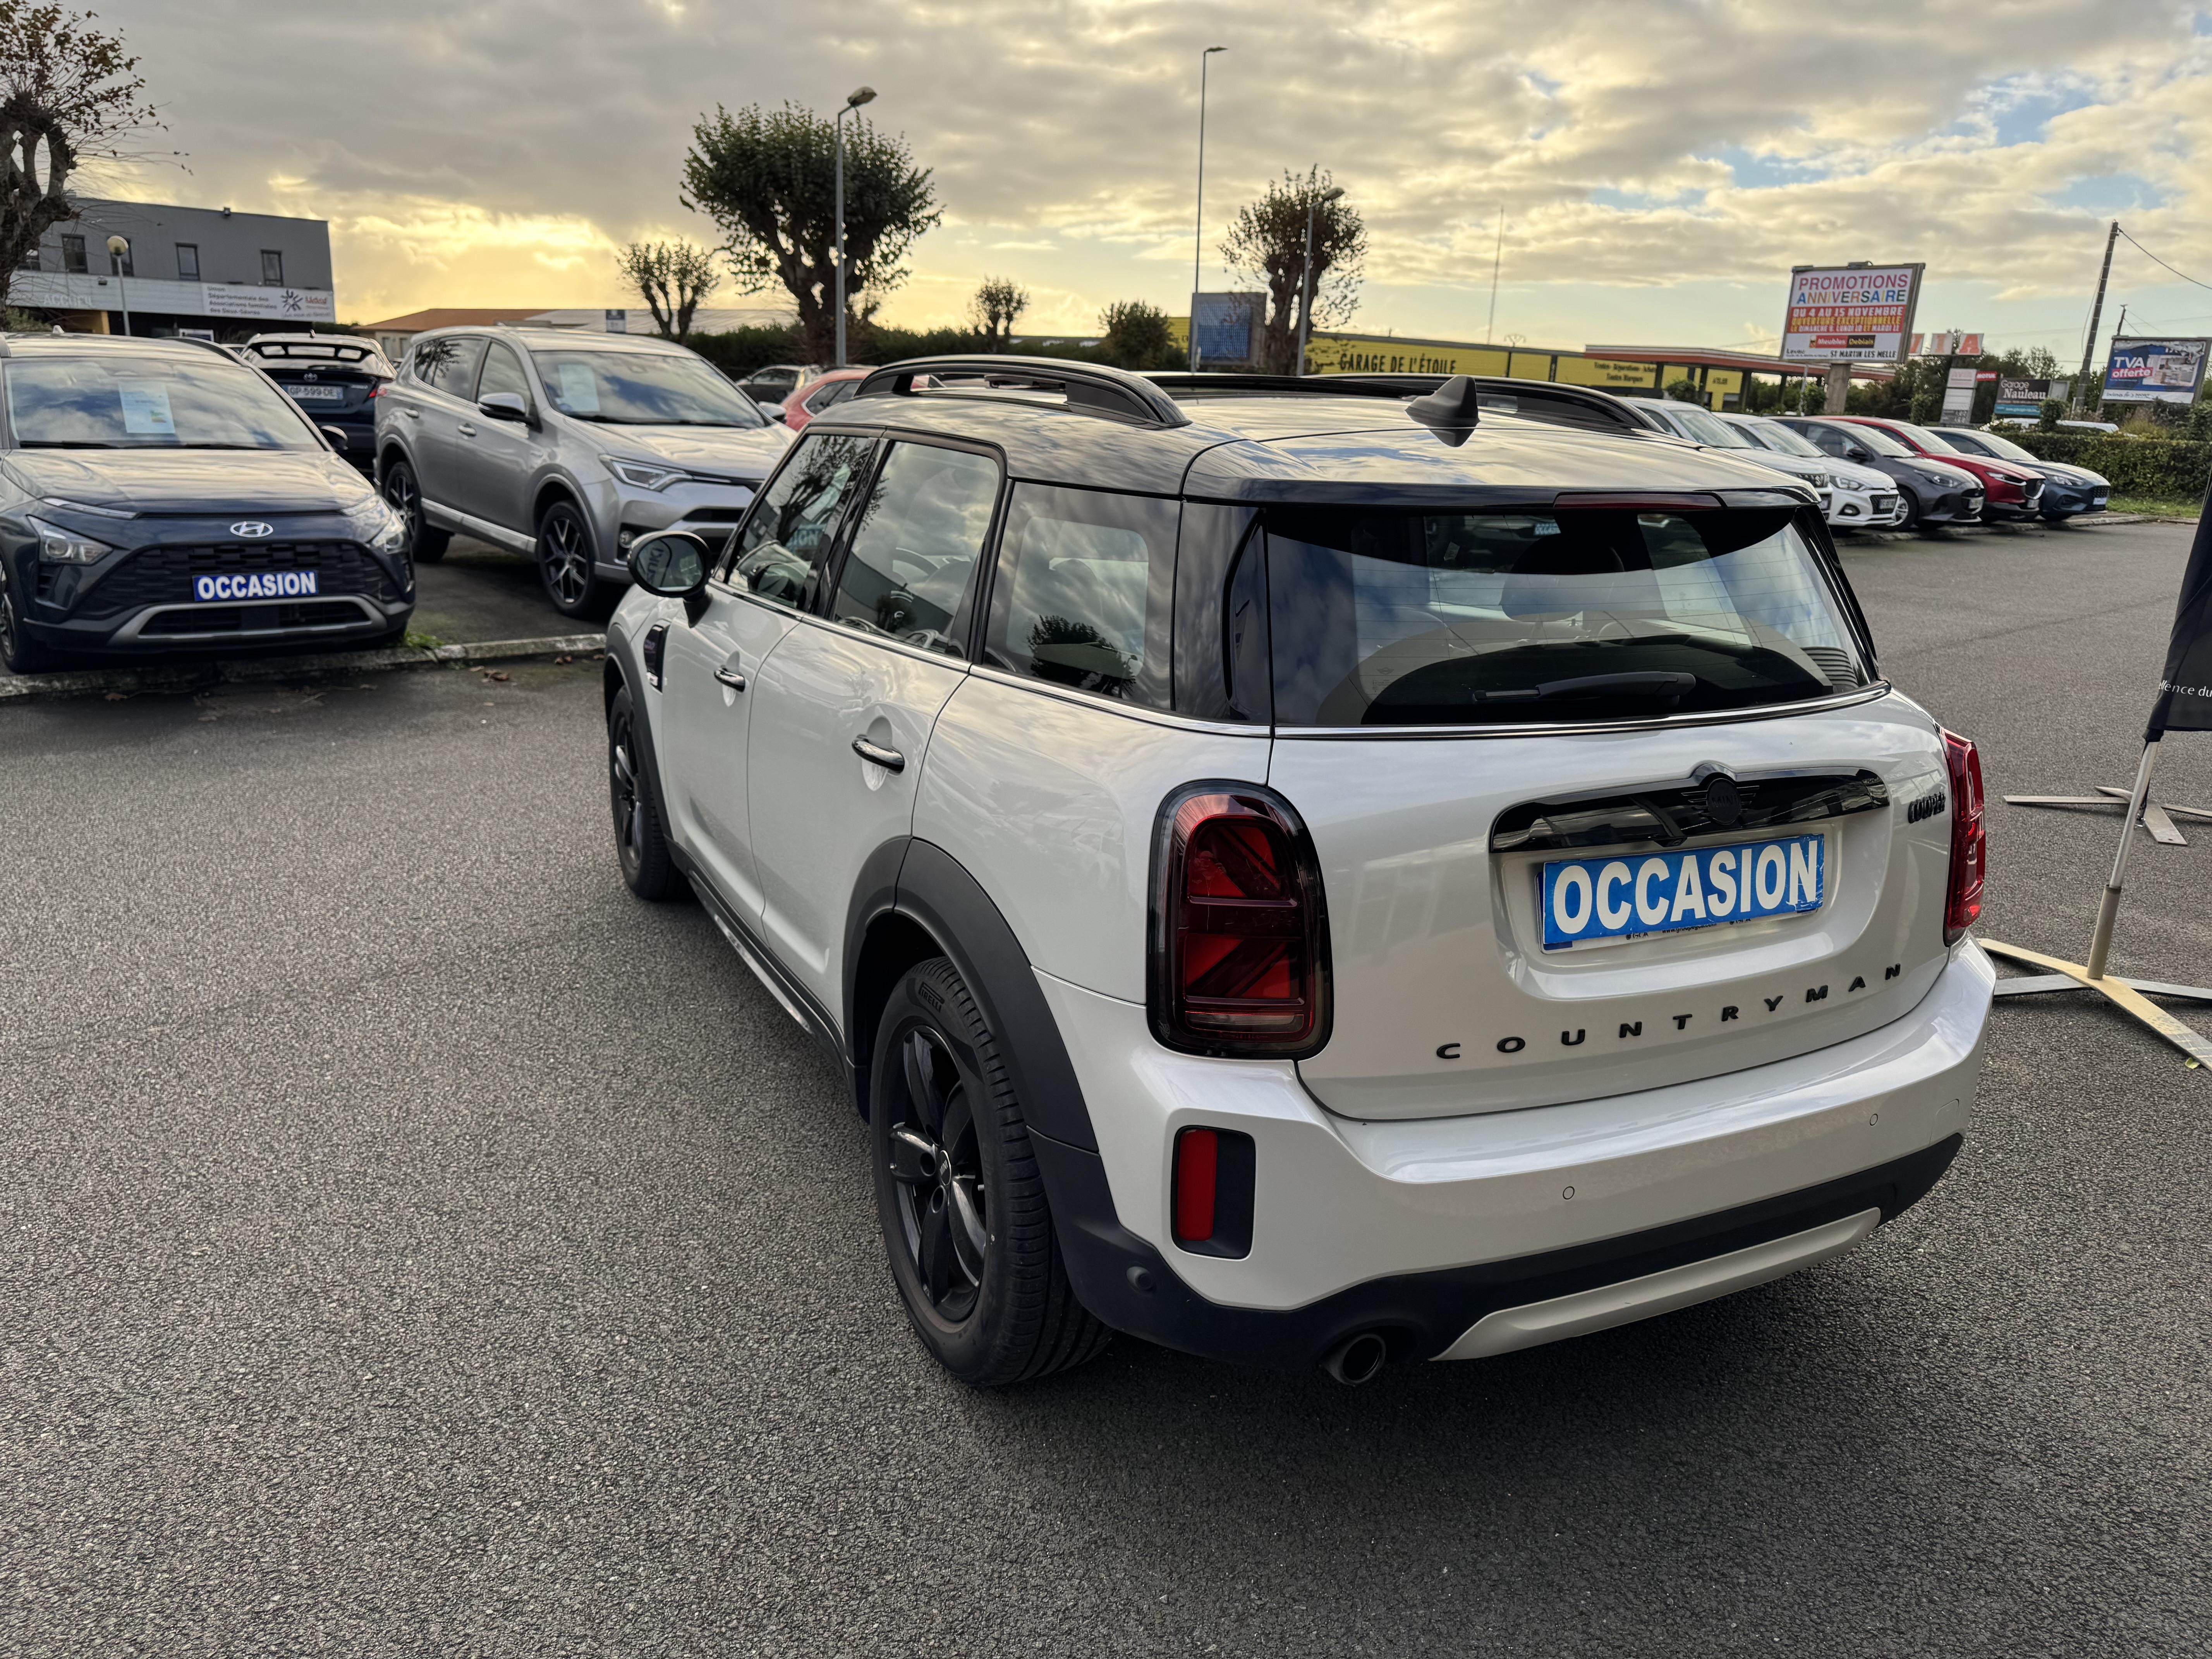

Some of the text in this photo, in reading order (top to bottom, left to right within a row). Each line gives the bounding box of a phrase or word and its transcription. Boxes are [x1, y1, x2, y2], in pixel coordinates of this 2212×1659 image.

[1799, 274, 1908, 290] PROMOTIONS
[1797, 290, 1906, 304] ANNIVERSAIRE
[1793, 308, 1806, 317] DU
[1818, 308, 1831, 317] AU
[1834, 308, 1844, 316] 15
[1848, 307, 1903, 316] NOVEMBRE
[1792, 316, 1901, 325] OUVERTURE EXCEPTIONNELLE
[1909, 334, 1980, 353] VIA
[1340, 353, 1456, 374] GARAGE DE L'ÉTOILE
[2114, 356, 2145, 368] TVA
[2112, 368, 2151, 378] offerte
[2001, 379, 2030, 390] Garage
[2002, 388, 2046, 400] Nauleau
[198, 572, 316, 600] OCCASION
[2198, 686, 2212, 697] du
[1712, 795, 1737, 809] MINI
[1908, 792, 1946, 824] COOPER
[1554, 840, 1817, 934] OCCASION
[918, 981, 945, 1013] PIRELLI
[1436, 963, 1901, 1060] COUNTRYMAN
[939, 1159, 948, 1176] MINI
